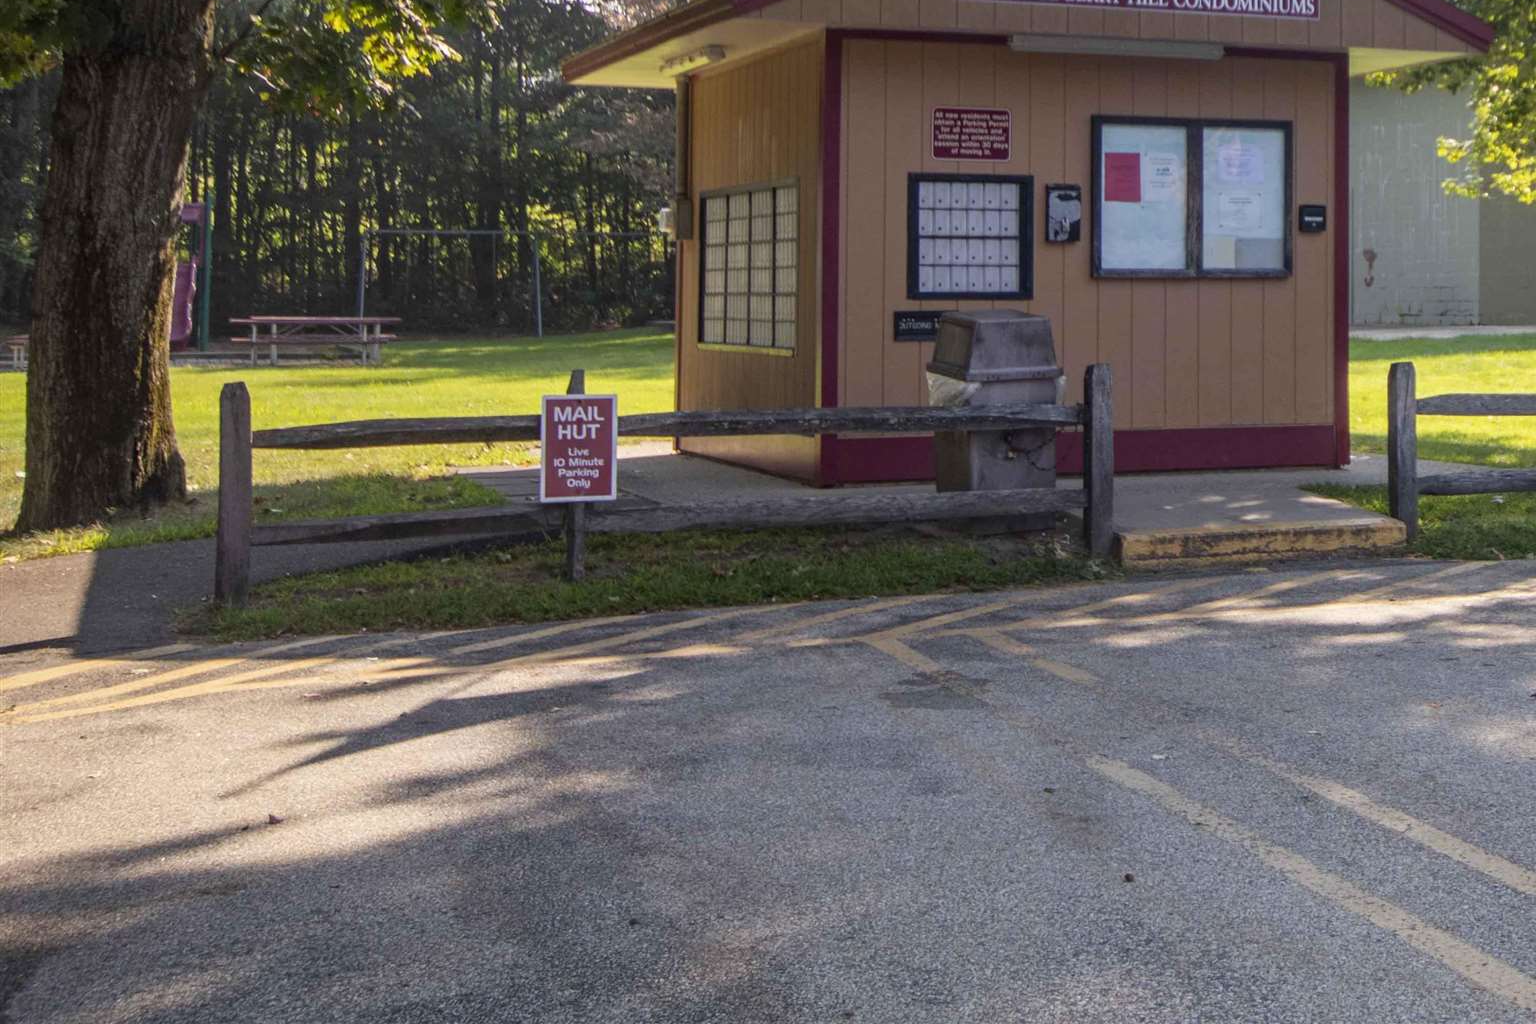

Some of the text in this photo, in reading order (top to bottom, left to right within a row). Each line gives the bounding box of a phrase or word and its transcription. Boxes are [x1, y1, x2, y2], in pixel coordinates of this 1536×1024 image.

[963, 120, 987, 128] Parking
[992, 142, 1009, 150] days
[553, 406, 605, 422] MAIL
[558, 424, 600, 440] HUT
[568, 447, 590, 456] Live
[553, 457, 605, 467] 10 Minute
[558, 468, 600, 478] Parking
[567, 478, 591, 488] Only
